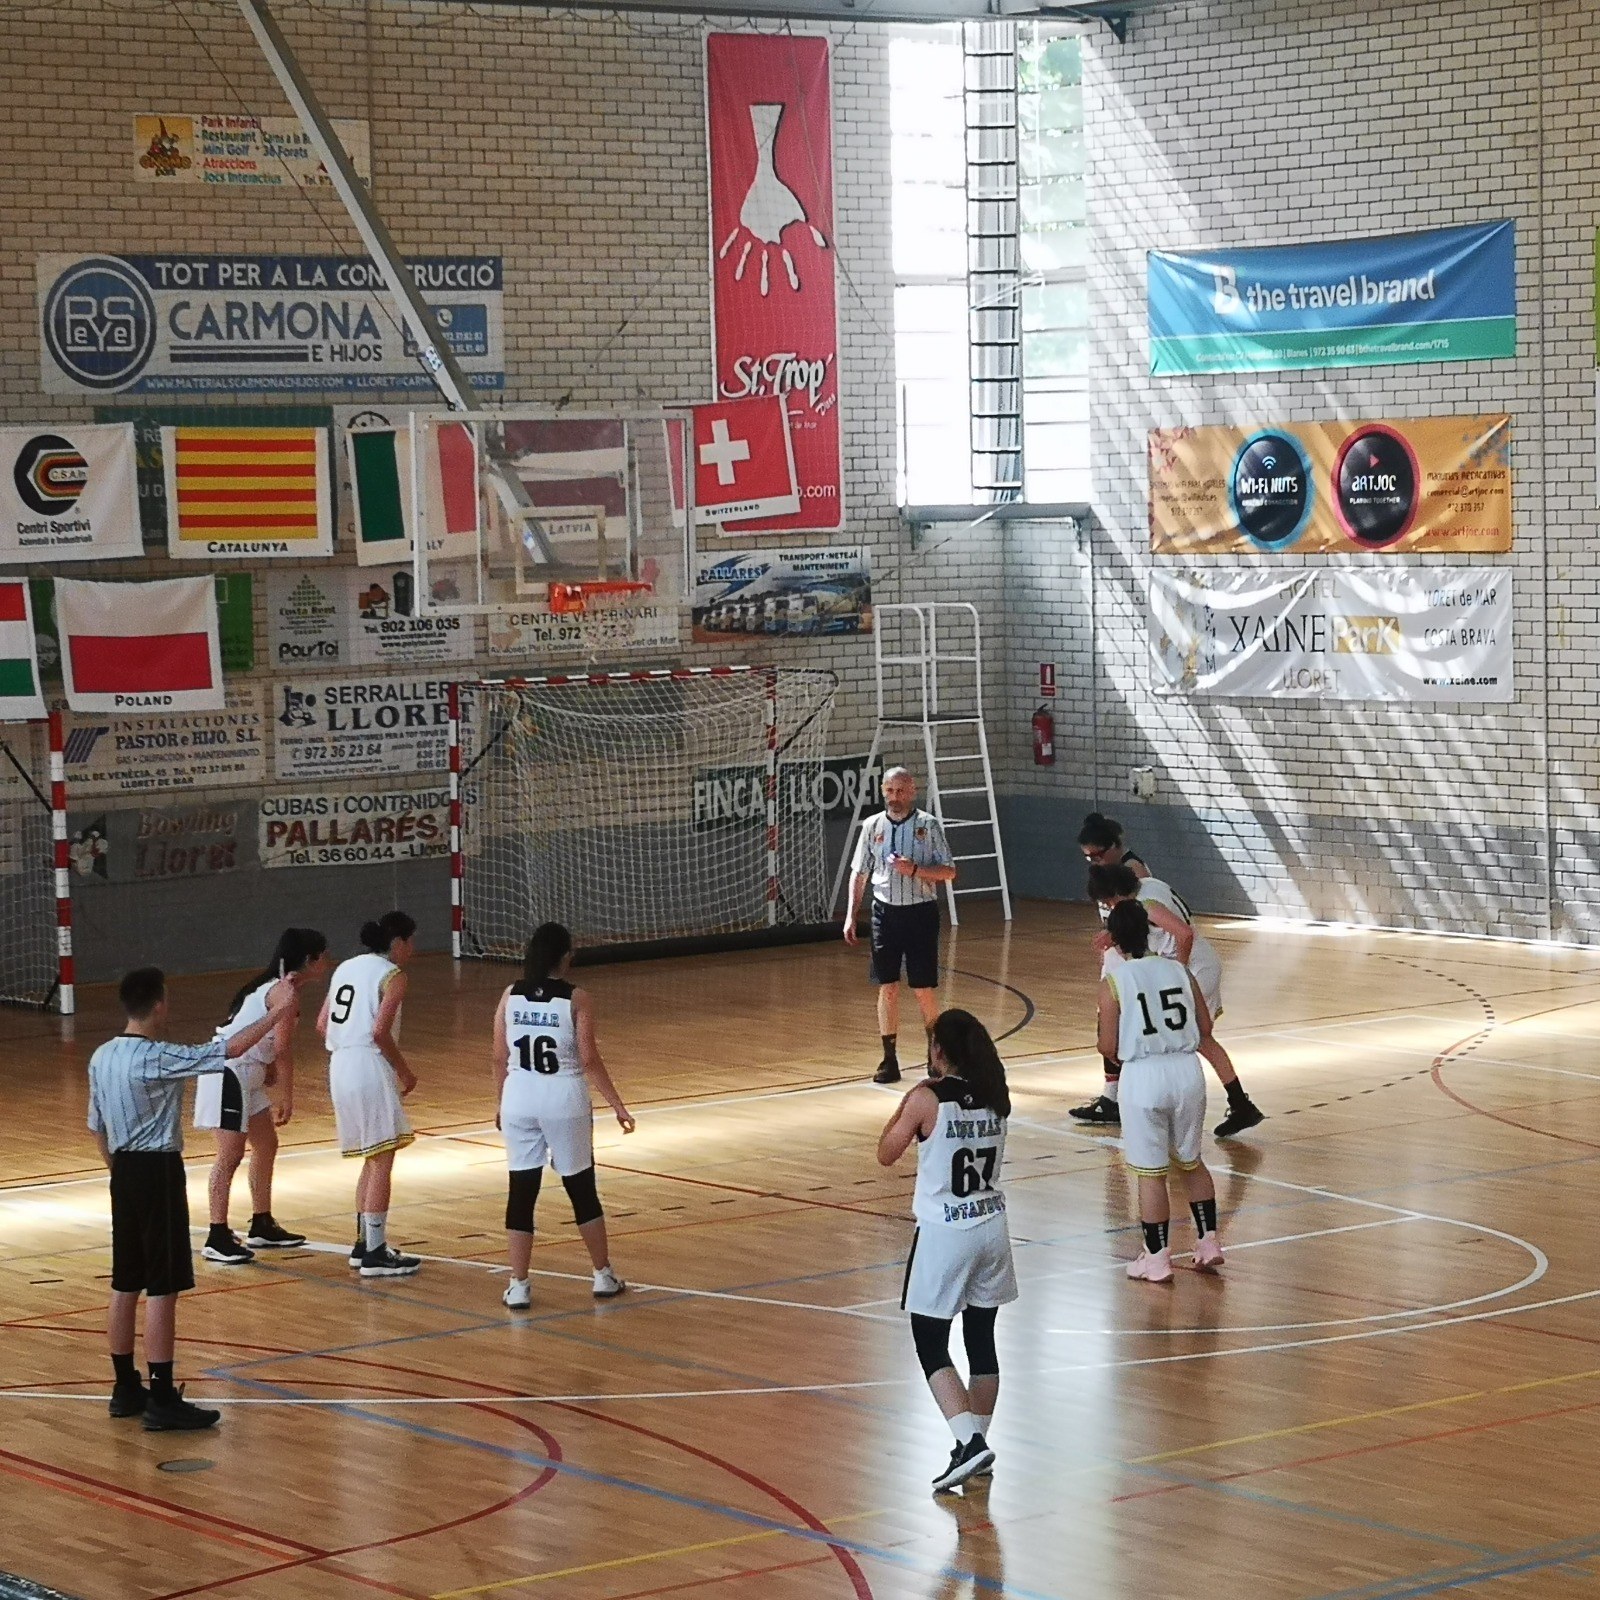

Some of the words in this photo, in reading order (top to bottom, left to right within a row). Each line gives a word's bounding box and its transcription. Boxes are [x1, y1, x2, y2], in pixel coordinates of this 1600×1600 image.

[201, 129, 256, 142] Restaurant
[155, 262, 209, 286] TOT
[218, 263, 262, 286] PER
[271, 263, 288, 286] A
[297, 263, 328, 287] LA
[337, 258, 495, 288] CONRUCCIÓ
[1246, 283, 1287, 313] the
[1291, 275, 1358, 309] travel
[1362, 267, 1436, 306] brand
[169, 300, 382, 342] CARMONA
[312, 344, 324, 362] E
[331, 343, 383, 363] HIJOS
[1314, 347, 1326, 356] 972
[1241, 477, 1269, 494] WI-FI
[1271, 476, 1298, 493] NUTS
[1374, 496, 1401, 504] TOGETHER
[705, 503, 760, 517] SWITZERLAND
[17, 520, 48, 535] Centri
[51, 519, 91, 535] Sportivi
[549, 522, 593, 535] LATVIA
[1426, 526, 1500, 539] www.artjoc.com
[207, 541, 289, 554] CATALUNYA
[792, 562, 850, 572] MANTENIMENT
[1459, 588, 1472, 606] de
[381, 619, 406, 633] 902
[409, 618, 433, 632] 106
[436, 617, 460, 630] 035
[510, 611, 569, 626] CENTRE
[534, 628, 555, 642] Tel.
[559, 627, 582, 641] 972
[1227, 614, 1326, 653] XAINE
[1424, 628, 1457, 646] COSTA
[1461, 628, 1496, 646] BRAVA
[1283, 667, 1342, 694] LLORET
[1423, 676, 1498, 686] www.xaine.com
[115, 694, 173, 707] POLAND
[113, 713, 261, 732] INSTALACIONES
[327, 700, 476, 732] LLORET
[115, 733, 179, 750] PASTOR
[181, 735, 189, 746] e
[304, 745, 327, 760] 972
[350, 743, 364, 757] 23
[693, 776, 767, 820] FINCA
[790, 765, 884, 813] LLORET
[260, 797, 328, 817] CUBAS
[289, 850, 315, 865] Tel.
[319, 849, 342, 863] 36
[344, 847, 368, 862] 60
[371, 846, 395, 860] 44
[330, 983, 355, 1025] 9
[1136, 987, 1188, 1036] 15
[513, 1034, 560, 1075] 16
[951, 1145, 997, 1199] 67
